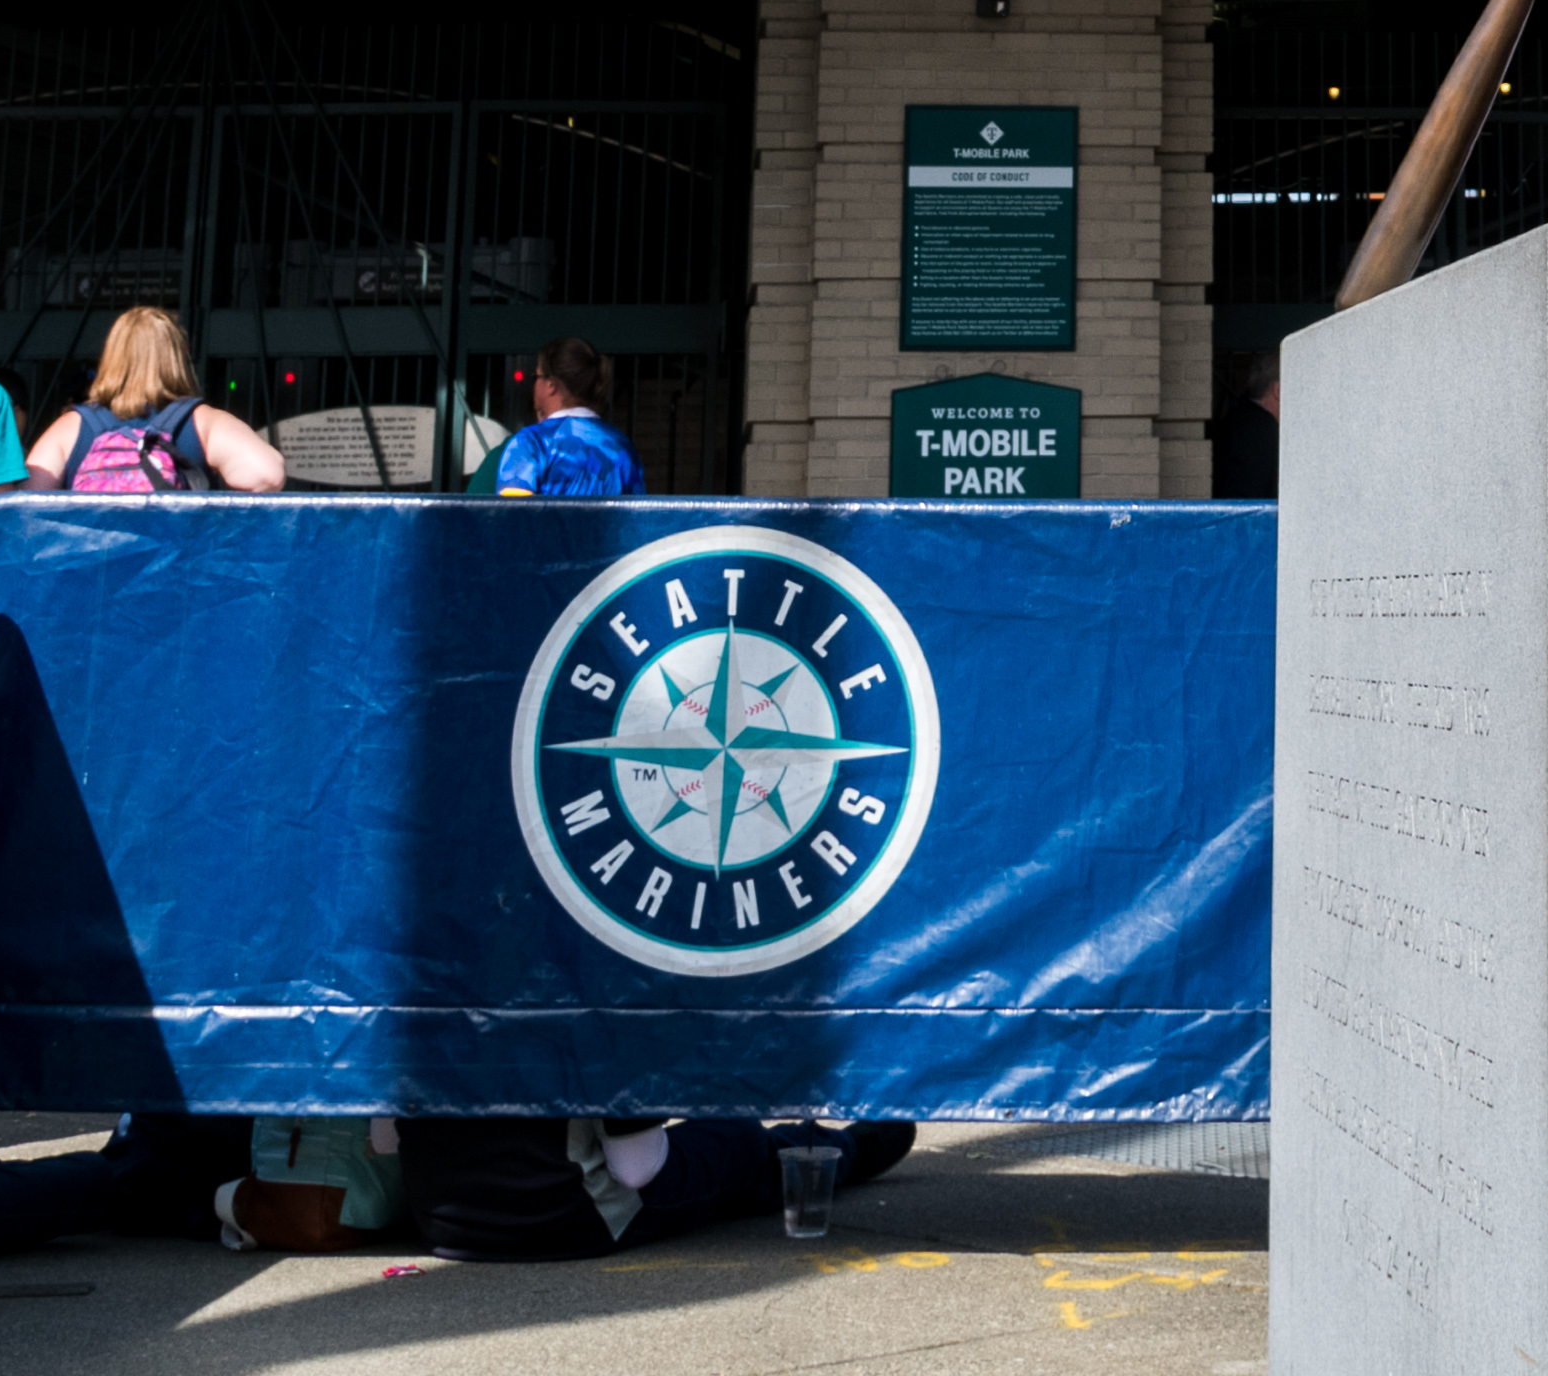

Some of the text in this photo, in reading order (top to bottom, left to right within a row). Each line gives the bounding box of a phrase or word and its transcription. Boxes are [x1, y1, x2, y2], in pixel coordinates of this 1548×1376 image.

[953, 147, 1030, 159] T-MOBILE PARK
[952, 171, 1030, 182] CODE OF CONDUCT
[931, 407, 1041, 420] WELCOME TO
[916, 429, 1057, 457] T-MOBILE
[944, 467, 1026, 495] PARK
[570, 568, 887, 701] SEATTLE
[560, 787, 886, 930] MARINERS
